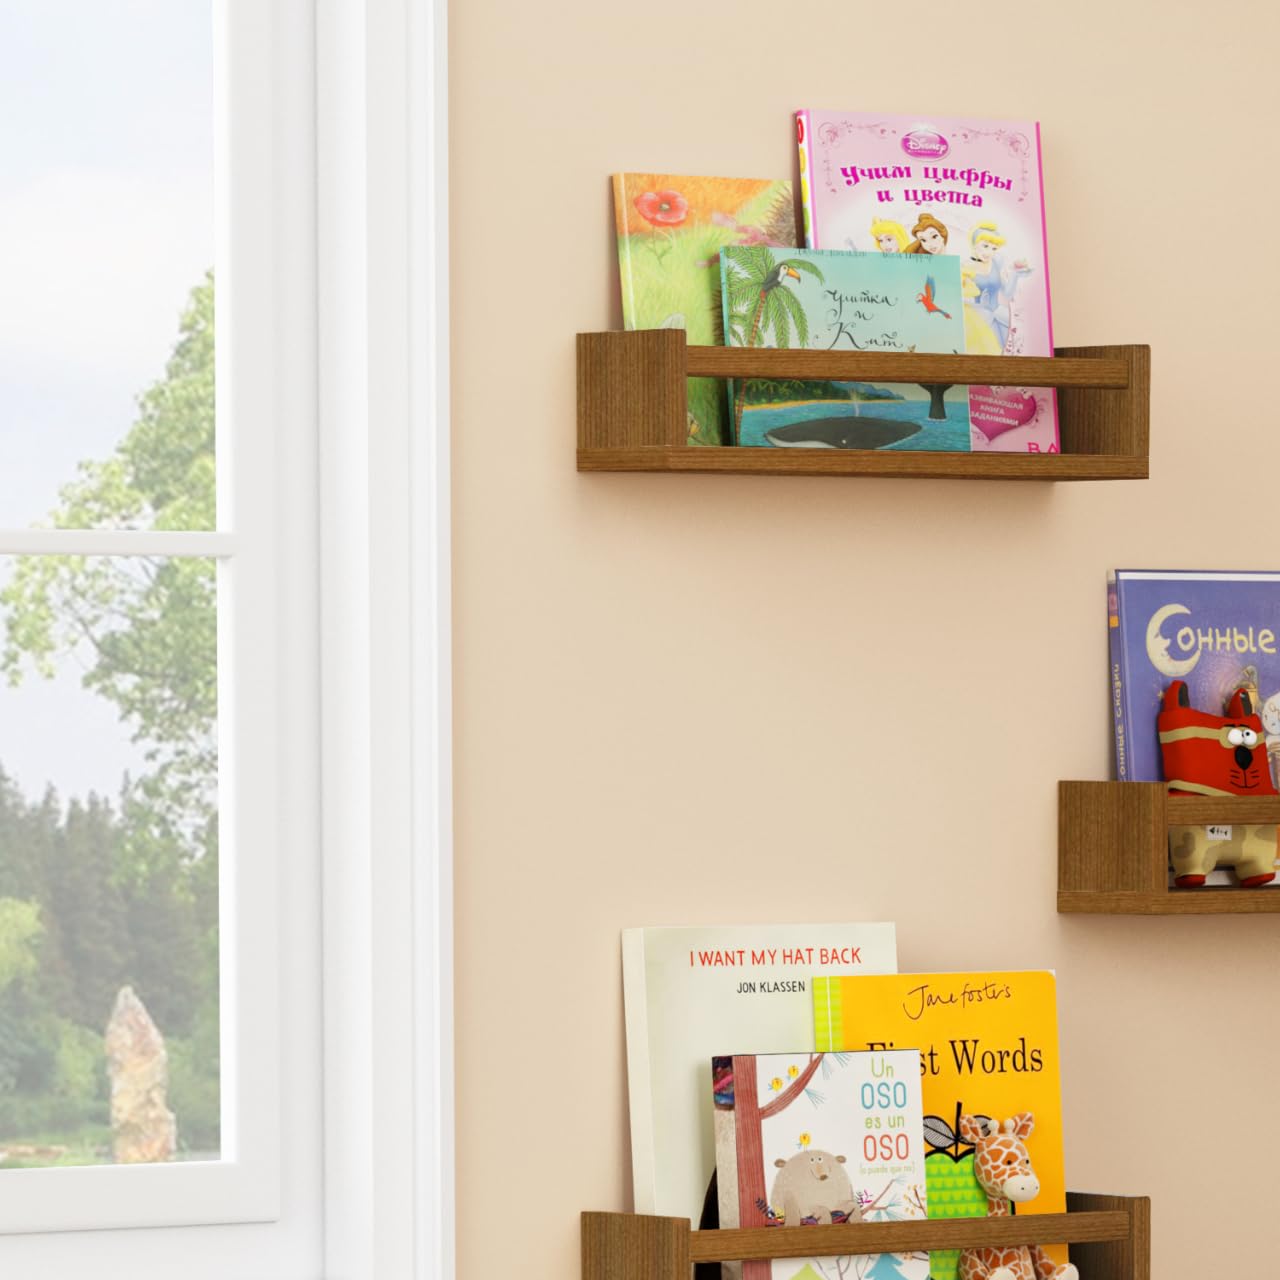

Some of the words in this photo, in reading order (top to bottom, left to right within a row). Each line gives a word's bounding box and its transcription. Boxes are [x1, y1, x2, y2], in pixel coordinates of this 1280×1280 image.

[923, 166, 1013, 192] цифры
[904, 188, 983, 208] цвета
[689, 950, 694, 967] I
[698, 950, 745, 967] WANT
[751, 949, 777, 965] MY
[782, 948, 814, 965] HAT
[819, 947, 862, 965] BACK
[736, 982, 757, 994] JON
[759, 980, 806, 993] KLASSEN
[949, 1037, 1044, 1074] Words
[870, 1057, 894, 1079] Un
[861, 1081, 907, 1109] OSO
[865, 1116, 881, 1129] es
[888, 1115, 905, 1129] un
[863, 1133, 909, 1162] OSO
